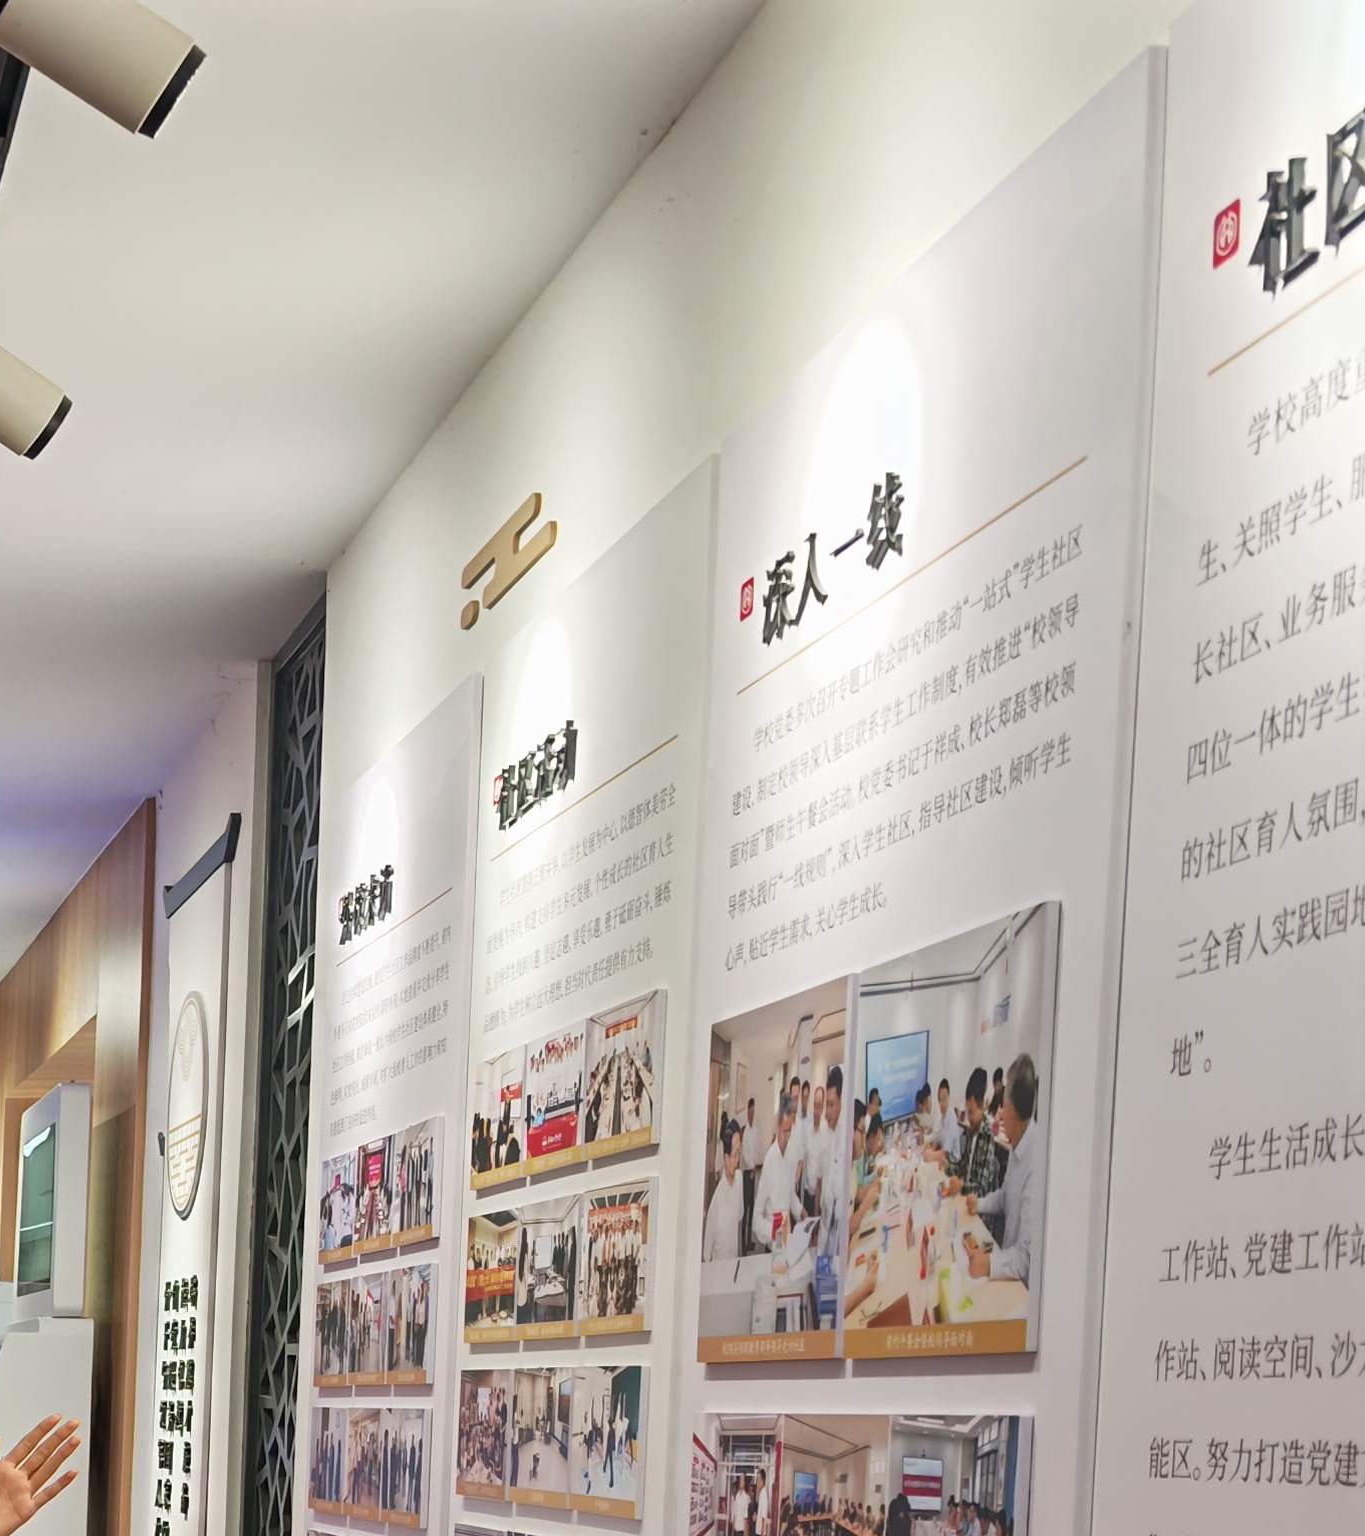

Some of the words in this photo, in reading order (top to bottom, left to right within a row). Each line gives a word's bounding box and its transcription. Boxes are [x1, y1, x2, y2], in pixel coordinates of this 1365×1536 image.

[1192, 563, 1365, 685] 长社区、业务服
[1170, 1030, 1213, 1077] 地”。
[1149, 1435, 1365, 1487] 能区。努力打造党建
